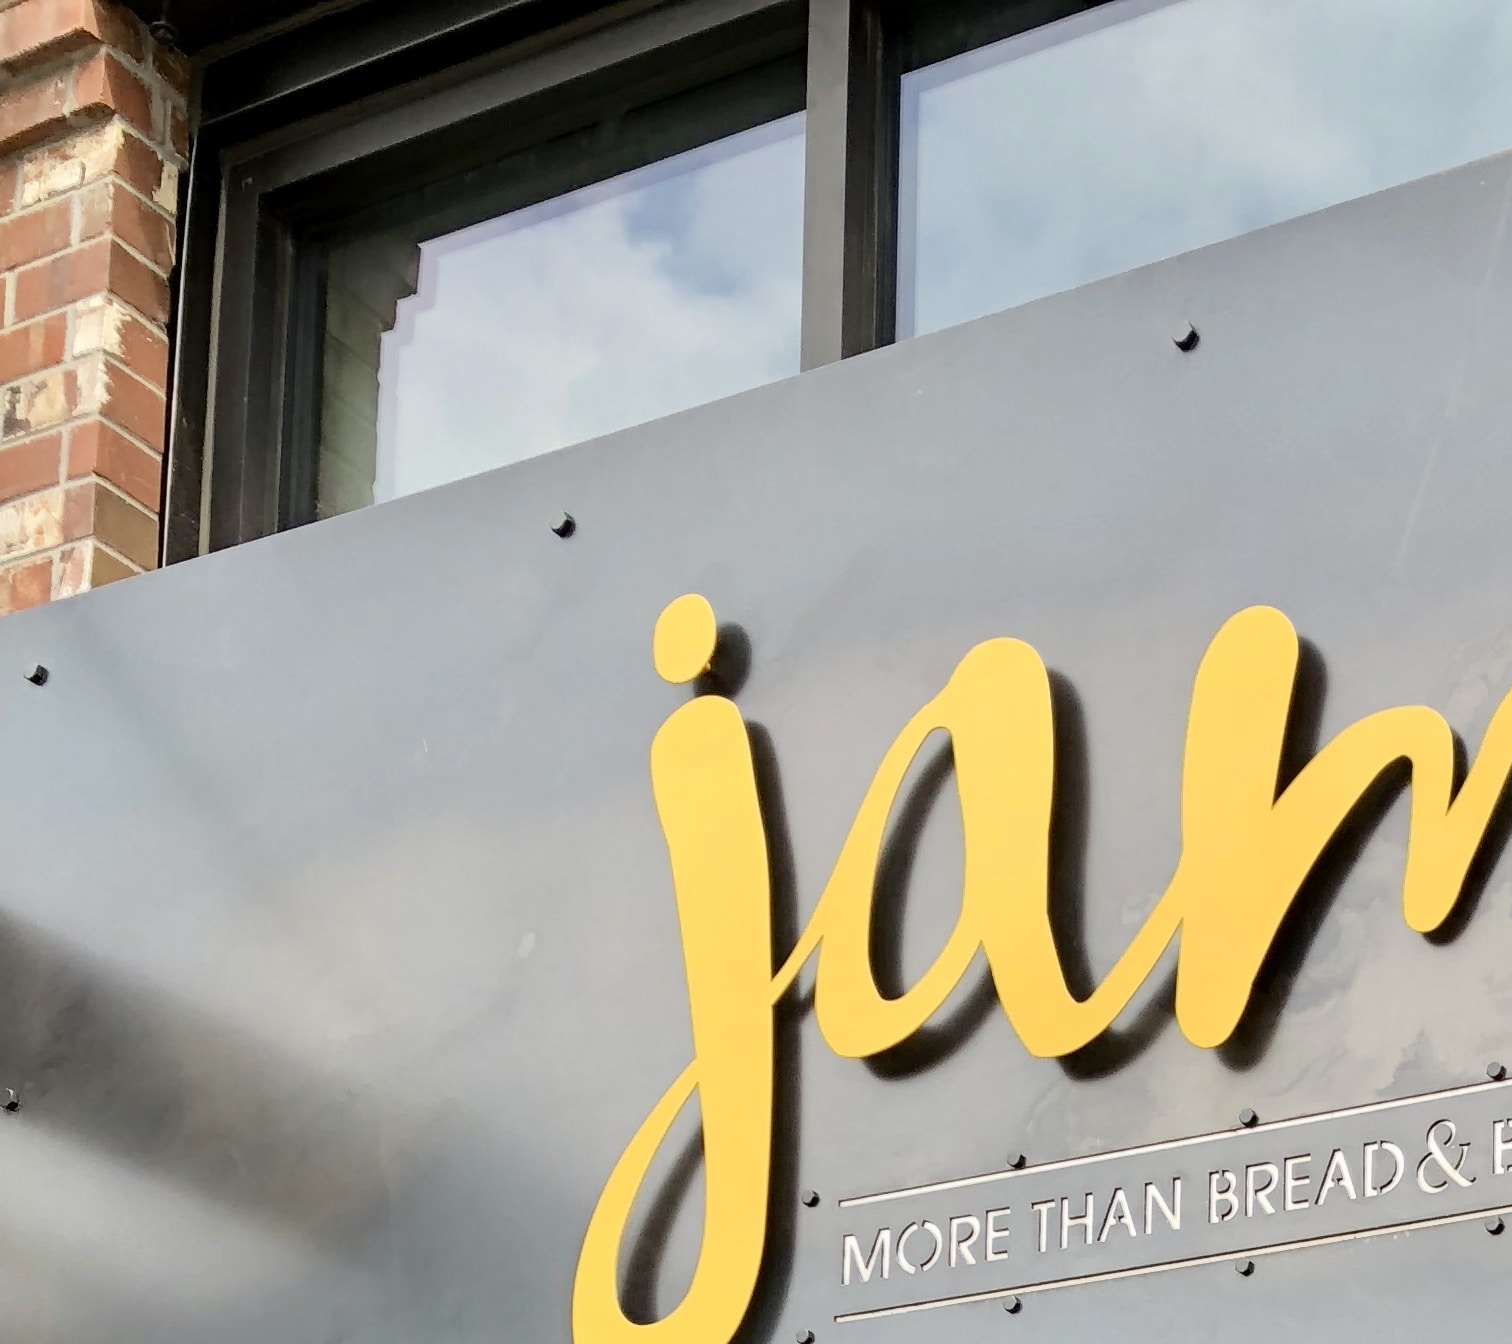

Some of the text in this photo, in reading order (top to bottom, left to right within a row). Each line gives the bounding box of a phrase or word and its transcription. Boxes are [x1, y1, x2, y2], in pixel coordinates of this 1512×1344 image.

[840, 1207, 1012, 1286] MORE
[1031, 1177, 1182, 1254] THAN
[1208, 1137, 1406, 1225] BREAD
[1415, 1118, 1477, 1195] &
